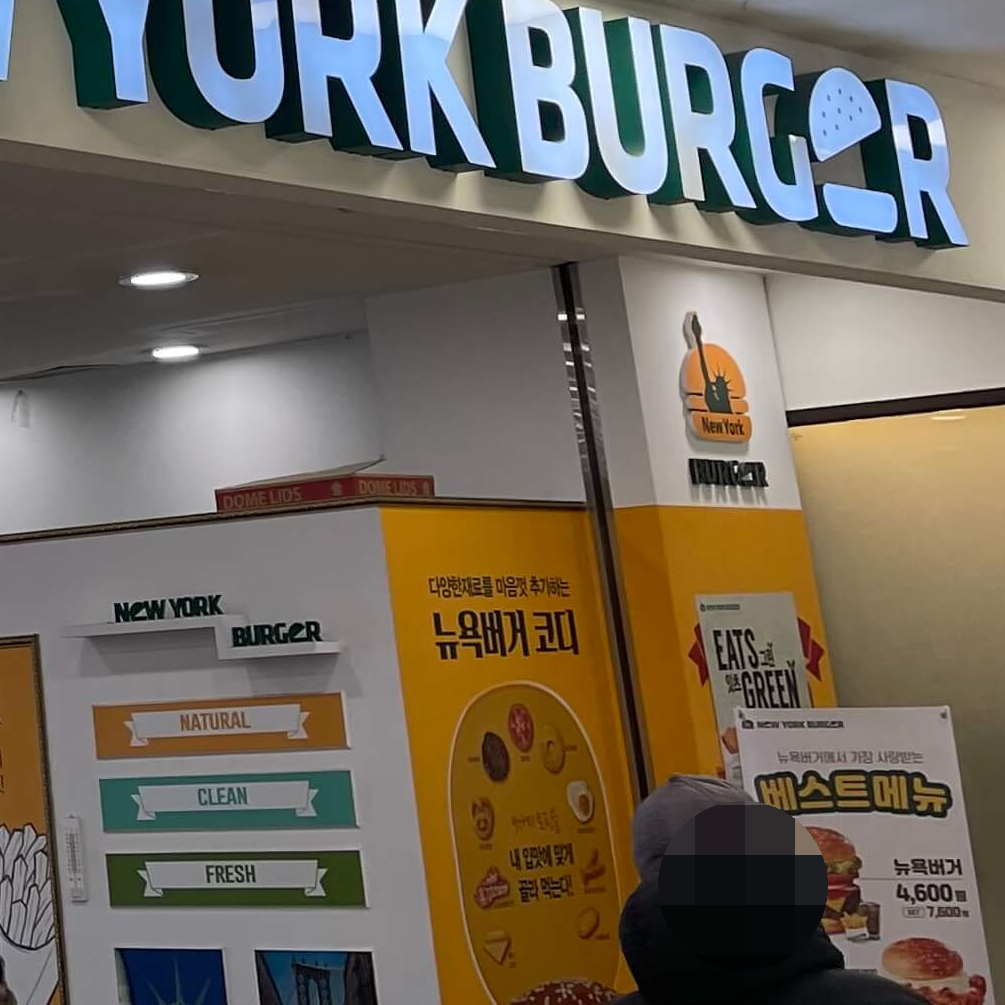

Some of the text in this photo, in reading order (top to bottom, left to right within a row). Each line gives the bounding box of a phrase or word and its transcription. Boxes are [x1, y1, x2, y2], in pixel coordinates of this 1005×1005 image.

[701, 416, 746, 436] New York
[358, 479, 418, 495] DOME LIDS
[223, 487, 302, 510] DOME LIDS
[495, 576, 528, 598] 마음껏
[530, 576, 572, 598] 추가하는
[168, 594, 224, 619] YORK
[433, 609, 580, 660] 뉴욕버거 코디
[712, 628, 759, 671] EATS
[741, 668, 802, 708] GREEN
[179, 710, 252, 732] NATURAL
[851, 750, 873, 765] 가장
[877, 750, 924, 765] 사랑받는
[197, 786, 249, 807] CLEAN
[756, 770, 952, 817] 베스트메뉴
[509, 848, 522, 871] 내
[522, 845, 553, 870] 입맛에
[893, 858, 963, 876] 뉴욕버거
[205, 864, 257, 883] FRESH
[518, 878, 540, 902] 골라
